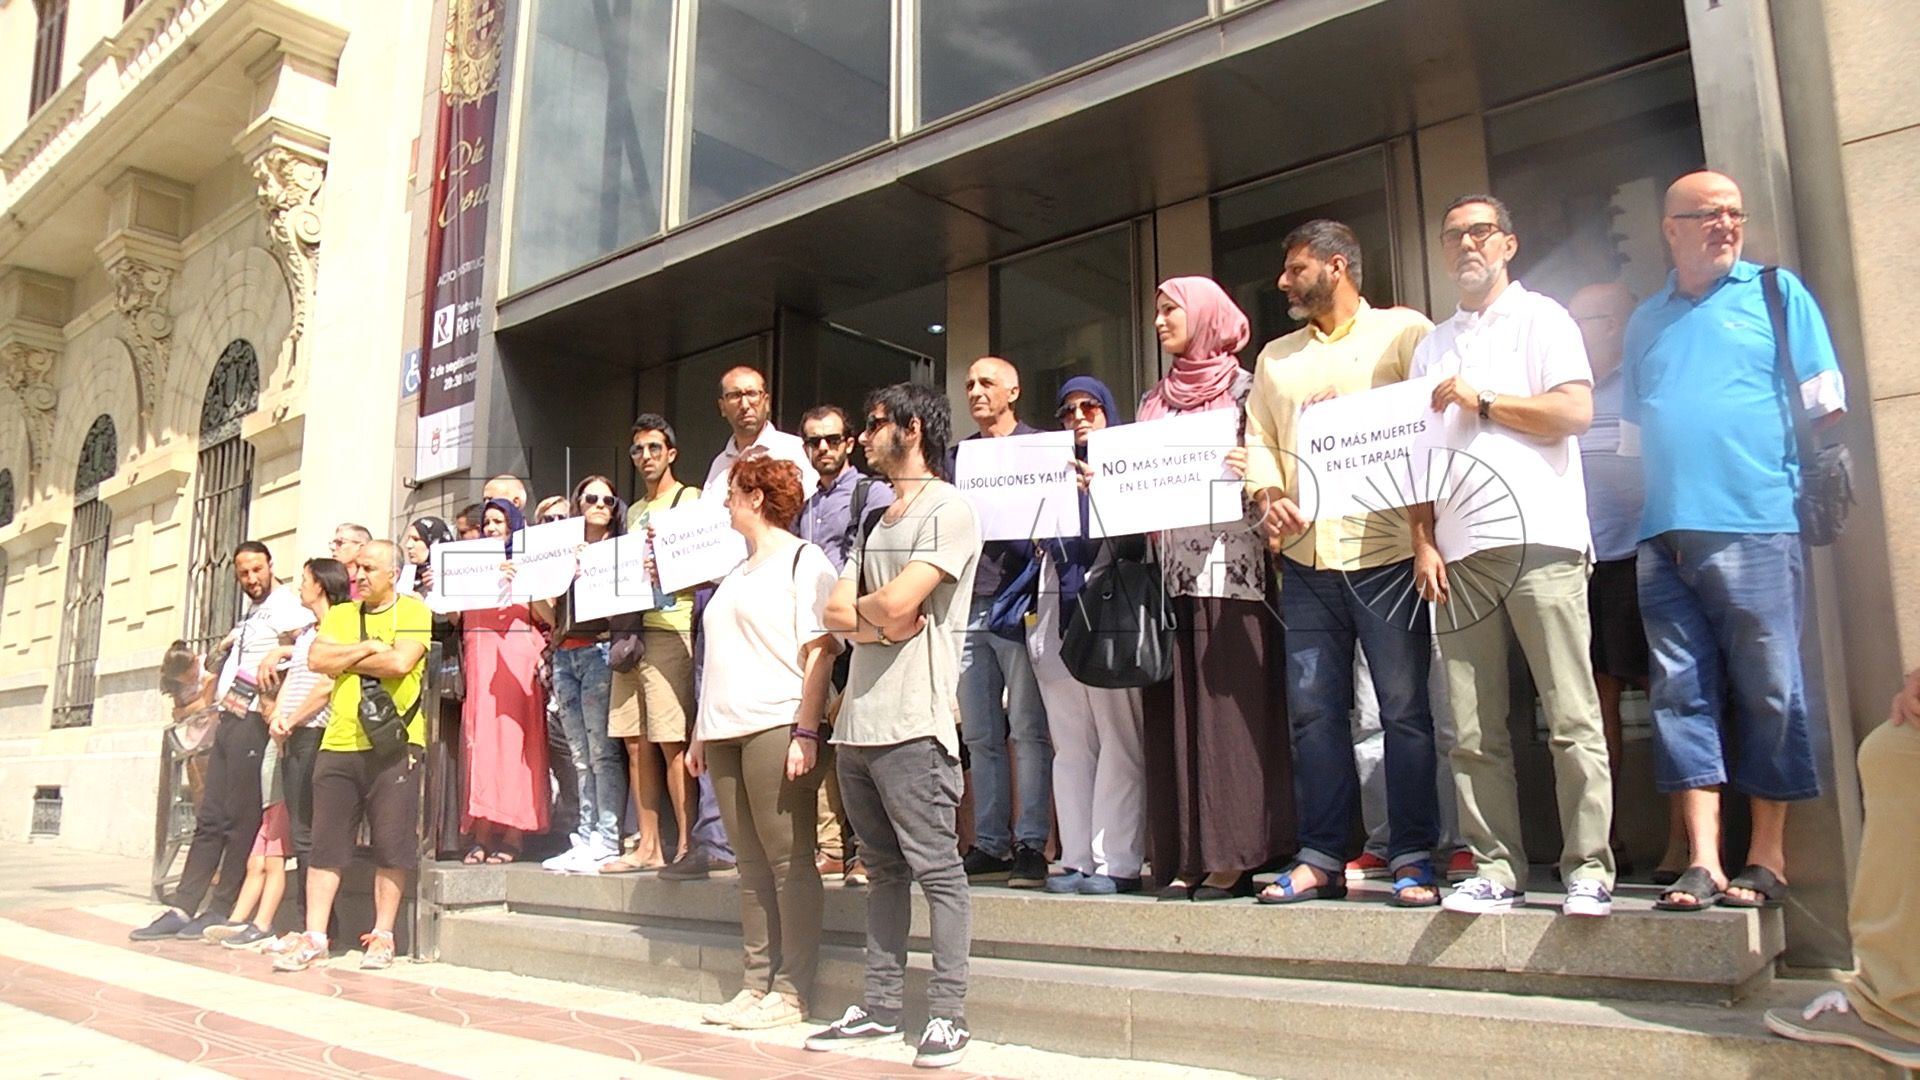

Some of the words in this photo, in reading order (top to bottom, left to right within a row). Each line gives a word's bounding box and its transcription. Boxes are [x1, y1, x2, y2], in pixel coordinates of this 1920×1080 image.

[430, 366, 436, 379] 2
[436, 364, 445, 377] de
[1311, 435, 1336, 454] NO
[1341, 432, 1367, 448] MÁS
[1370, 420, 1426, 442] MUERTES
[1102, 459, 1127, 476] NO
[1162, 449, 1217, 466] MUERTES
[1327, 459, 1341, 472] EN
[1345, 457, 1357, 469] EL
[1361, 447, 1410, 466] TARAJAL
[1038, 471, 1067, 483] YA!!!
[1119, 482, 1133, 493] EN
[1137, 480, 1148, 491] EL
[1153, 472, 1201, 488] TARAJAL
[661, 533, 676, 548] NO
